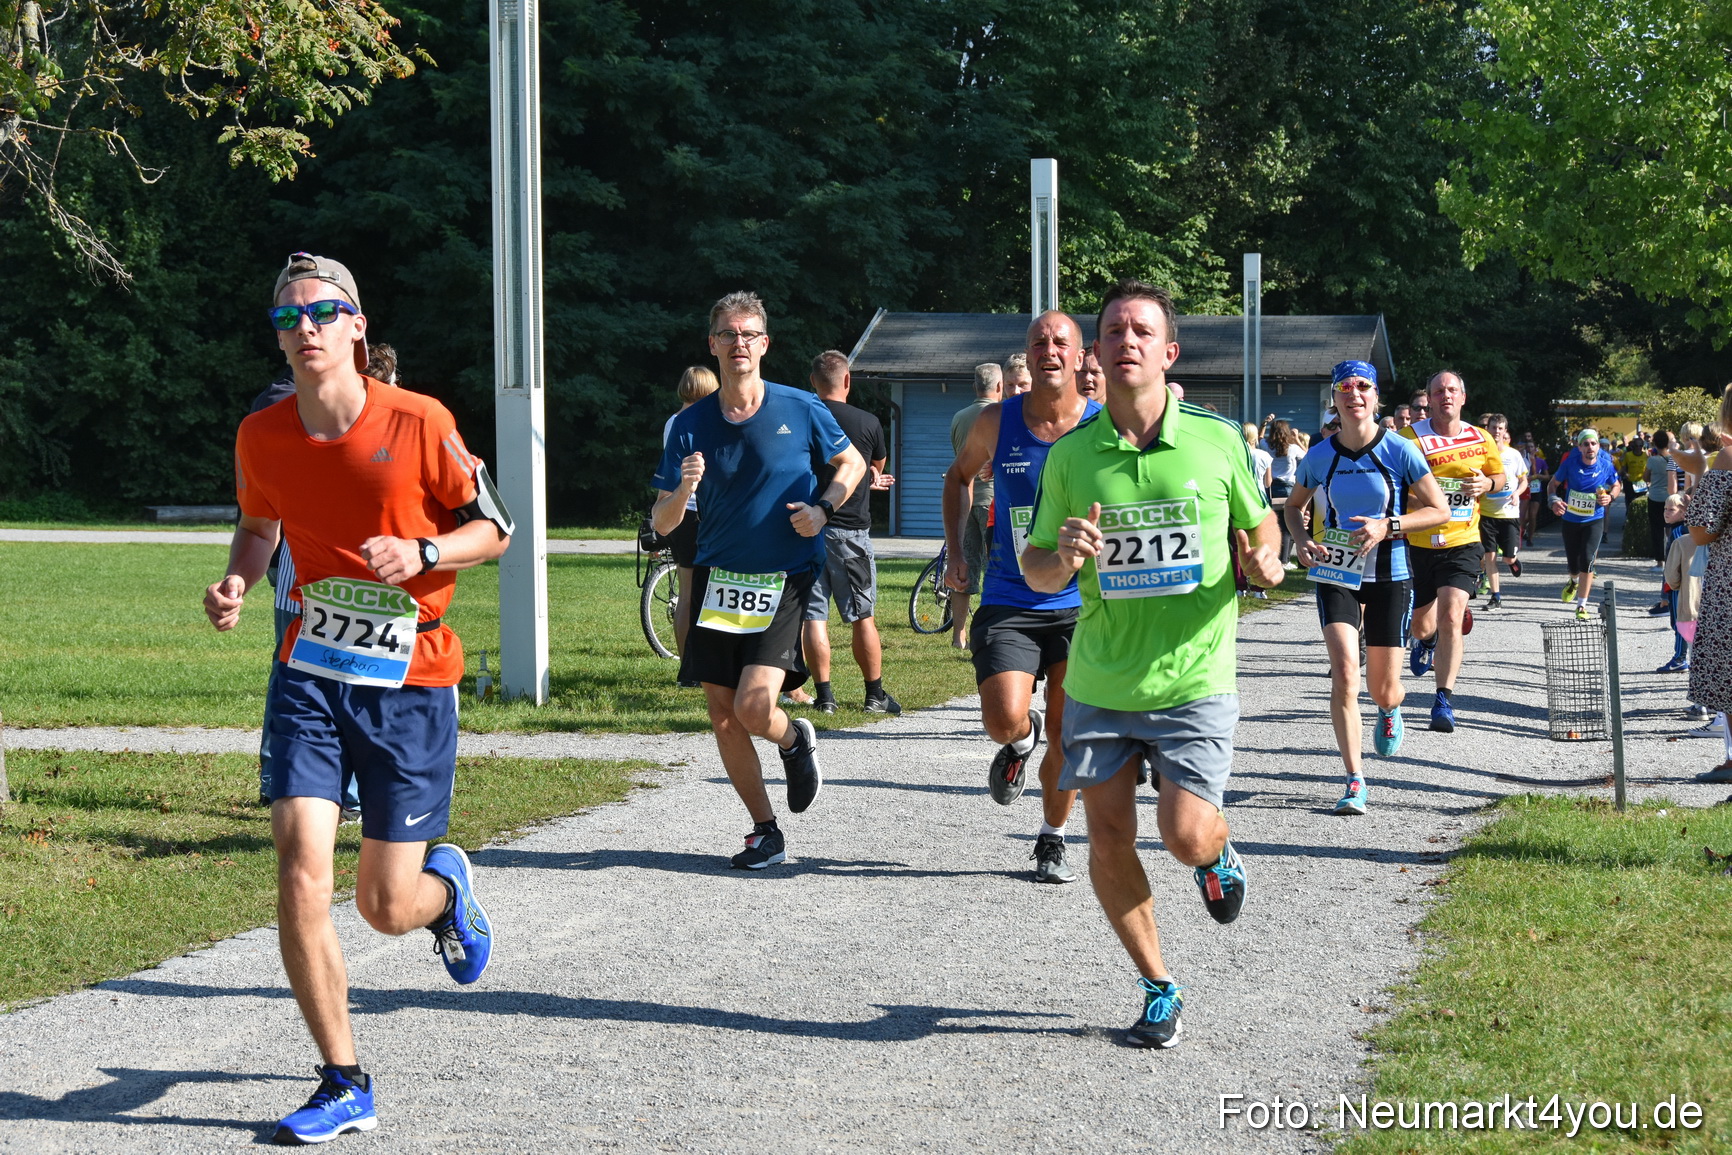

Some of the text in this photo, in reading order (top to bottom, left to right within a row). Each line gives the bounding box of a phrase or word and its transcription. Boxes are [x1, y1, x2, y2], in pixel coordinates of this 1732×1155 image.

[1429, 447, 1488, 467] MAX BÖGL
[1445, 493, 1470, 506] 398
[1571, 499, 1592, 509] 1134
[1099, 503, 1188, 529] BOCK
[1105, 532, 1189, 566] 2212
[1314, 546, 1359, 568] 637
[715, 568, 776, 586] BOCK
[1107, 569, 1193, 587] THORSTEN
[1316, 568, 1344, 580] ANIKA
[310, 581, 406, 612] BOCK
[716, 587, 772, 612] 1385
[311, 607, 399, 652] 2724
